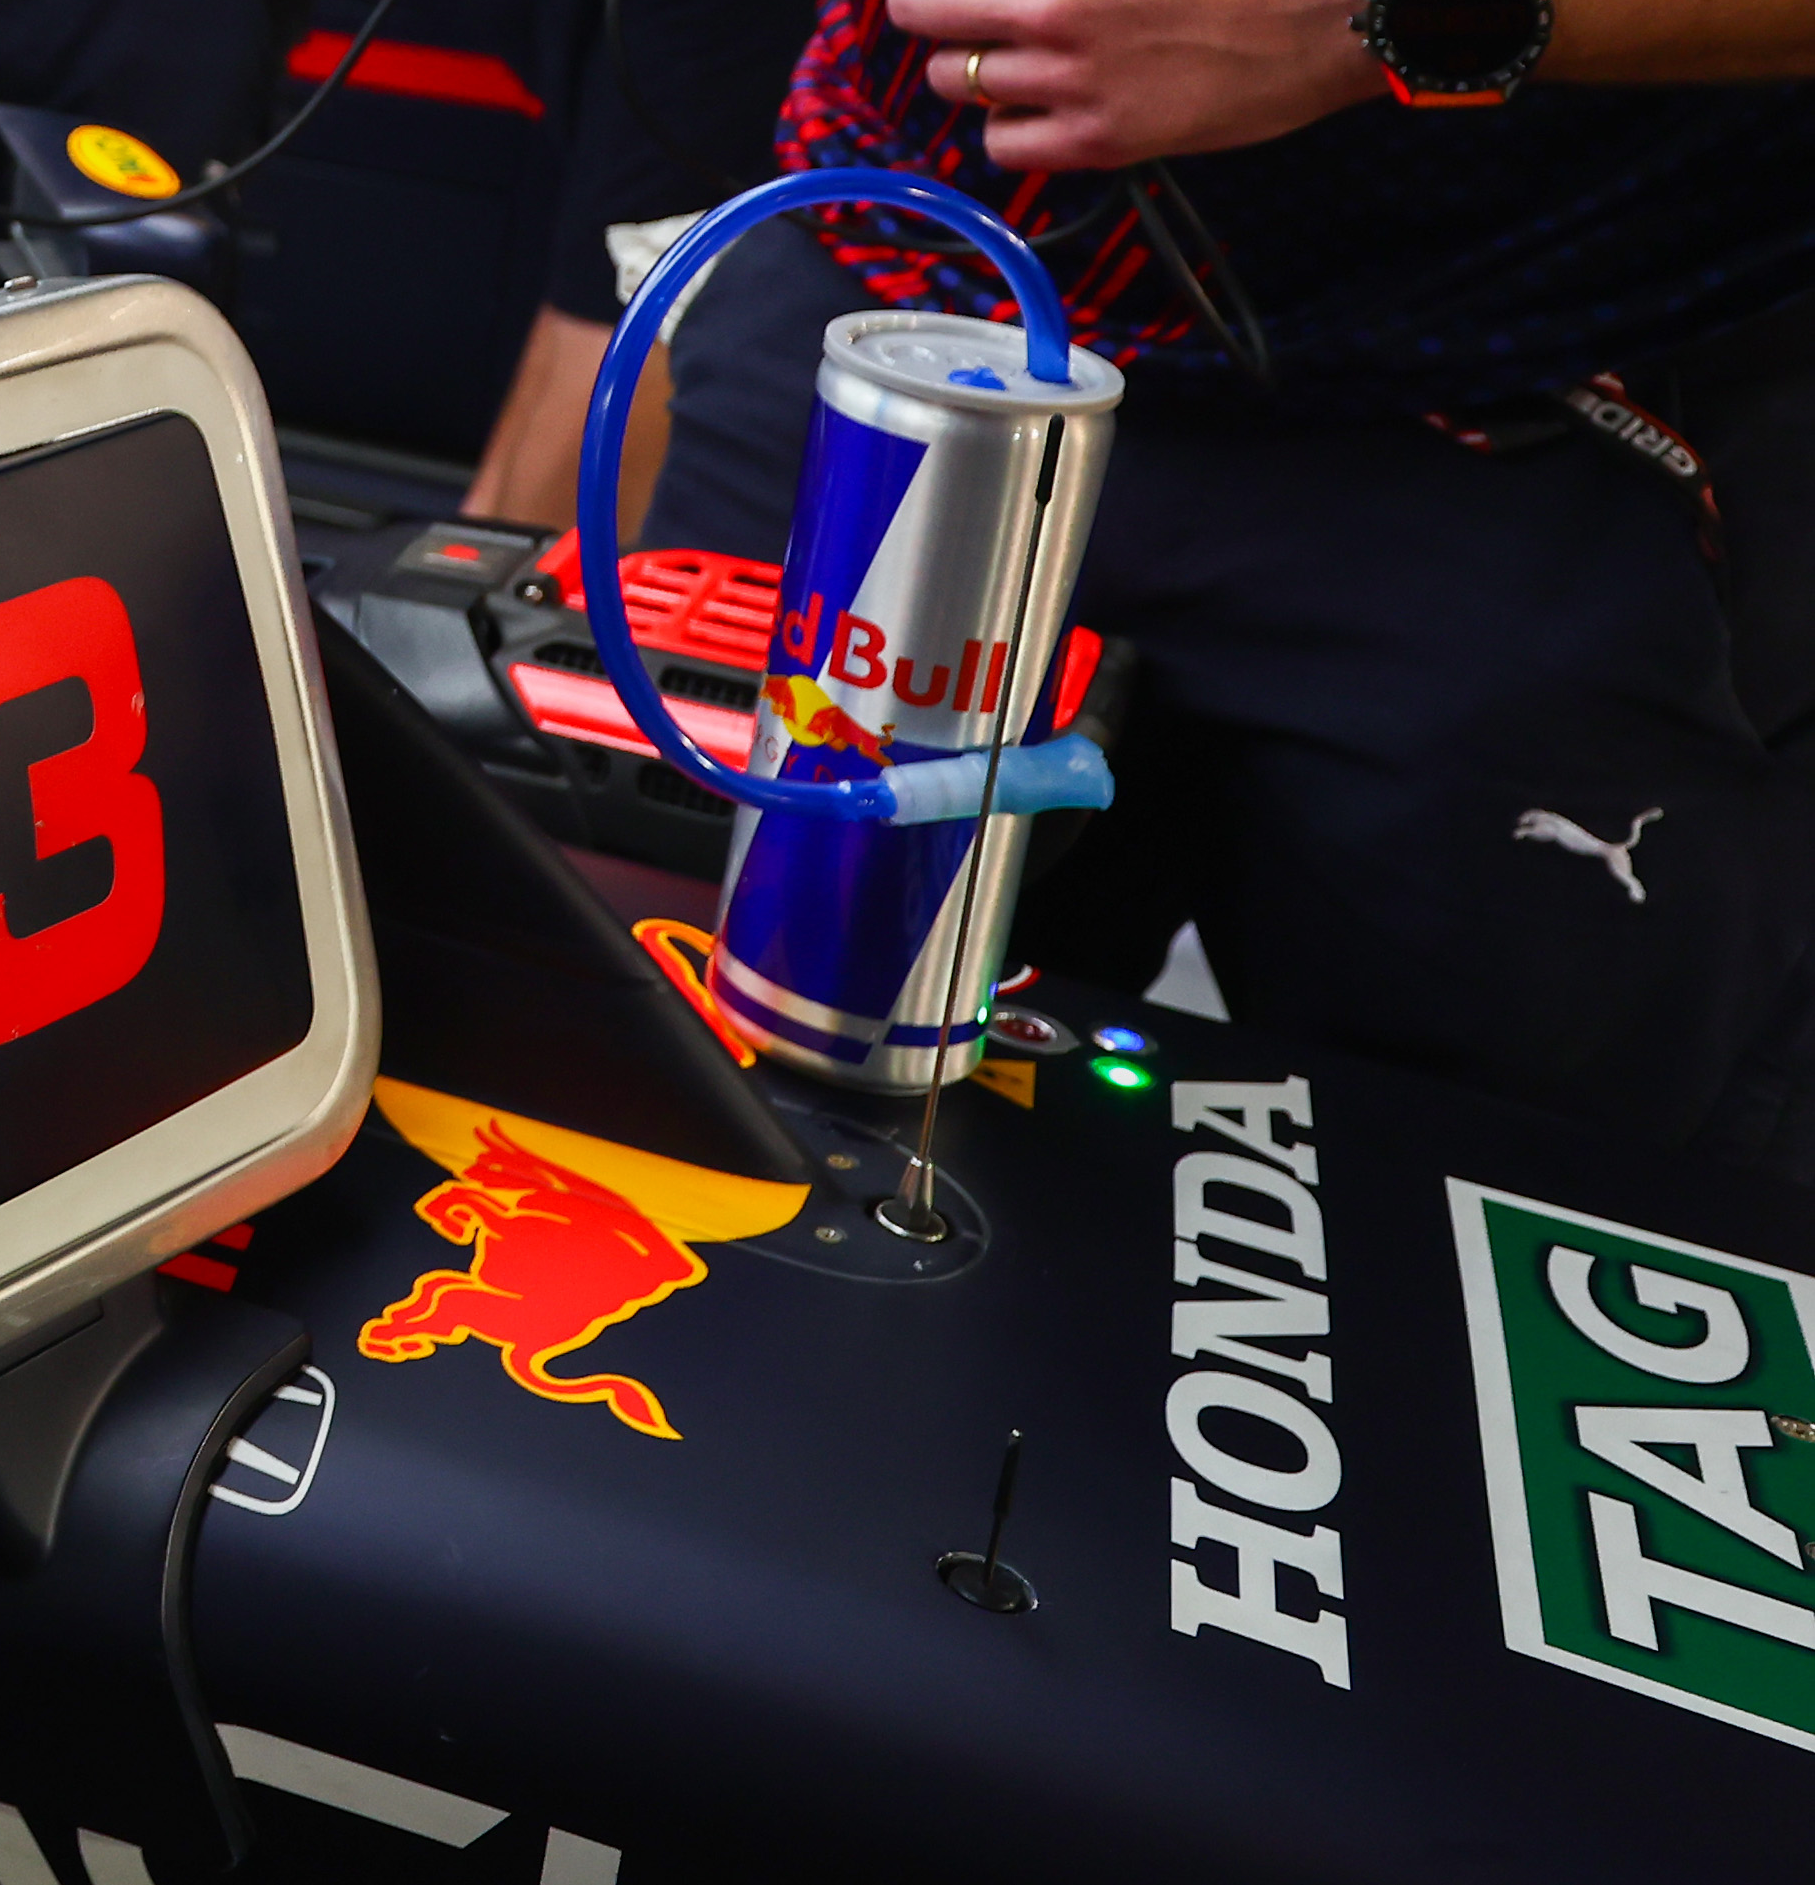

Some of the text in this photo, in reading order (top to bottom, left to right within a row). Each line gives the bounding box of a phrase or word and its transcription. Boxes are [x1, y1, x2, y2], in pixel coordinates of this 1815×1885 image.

[827, 609, 1009, 715] Bull
[1165, 1074, 1352, 1692] HONDA
[1546, 1243, 1815, 1655] TAG
